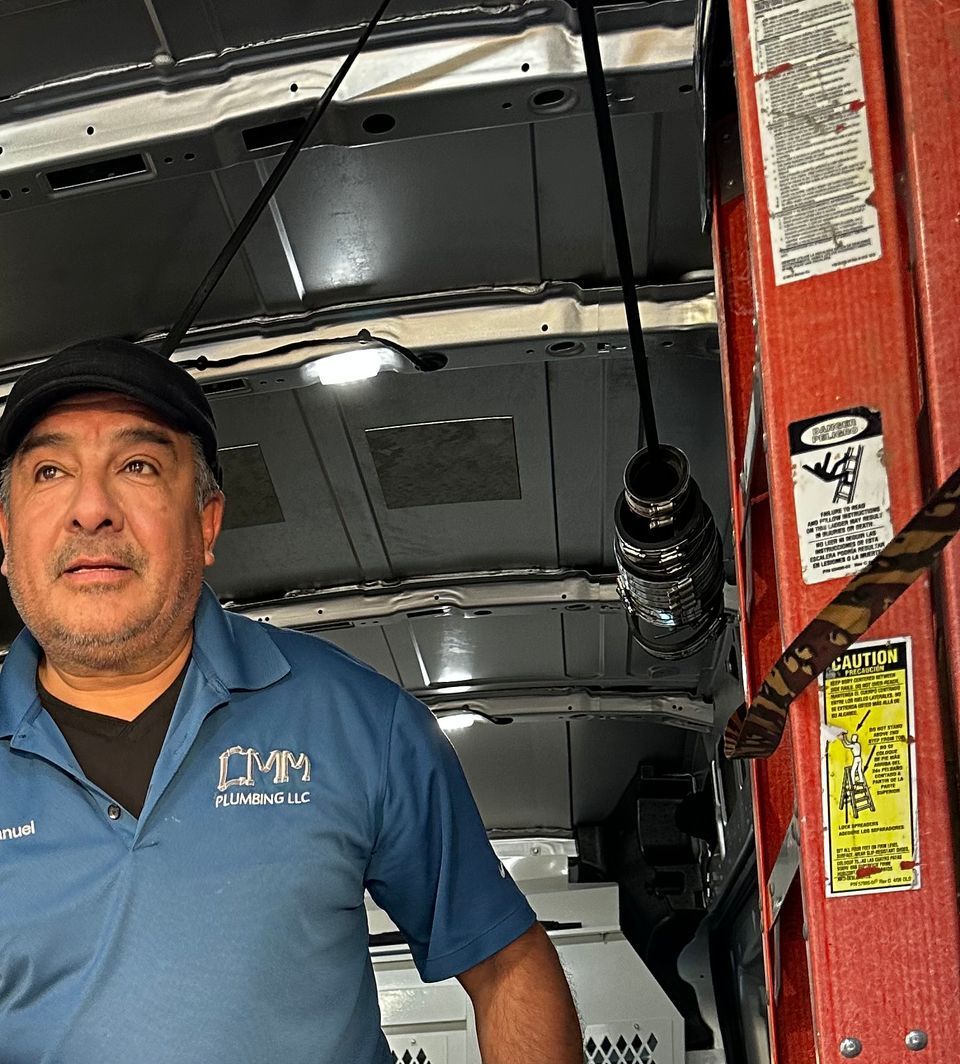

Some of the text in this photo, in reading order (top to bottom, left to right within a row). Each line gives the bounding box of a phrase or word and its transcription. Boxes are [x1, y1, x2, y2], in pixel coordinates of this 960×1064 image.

[832, 648, 898, 671] CAUTION
[215, 791, 311, 808] PLUMBING LLC
